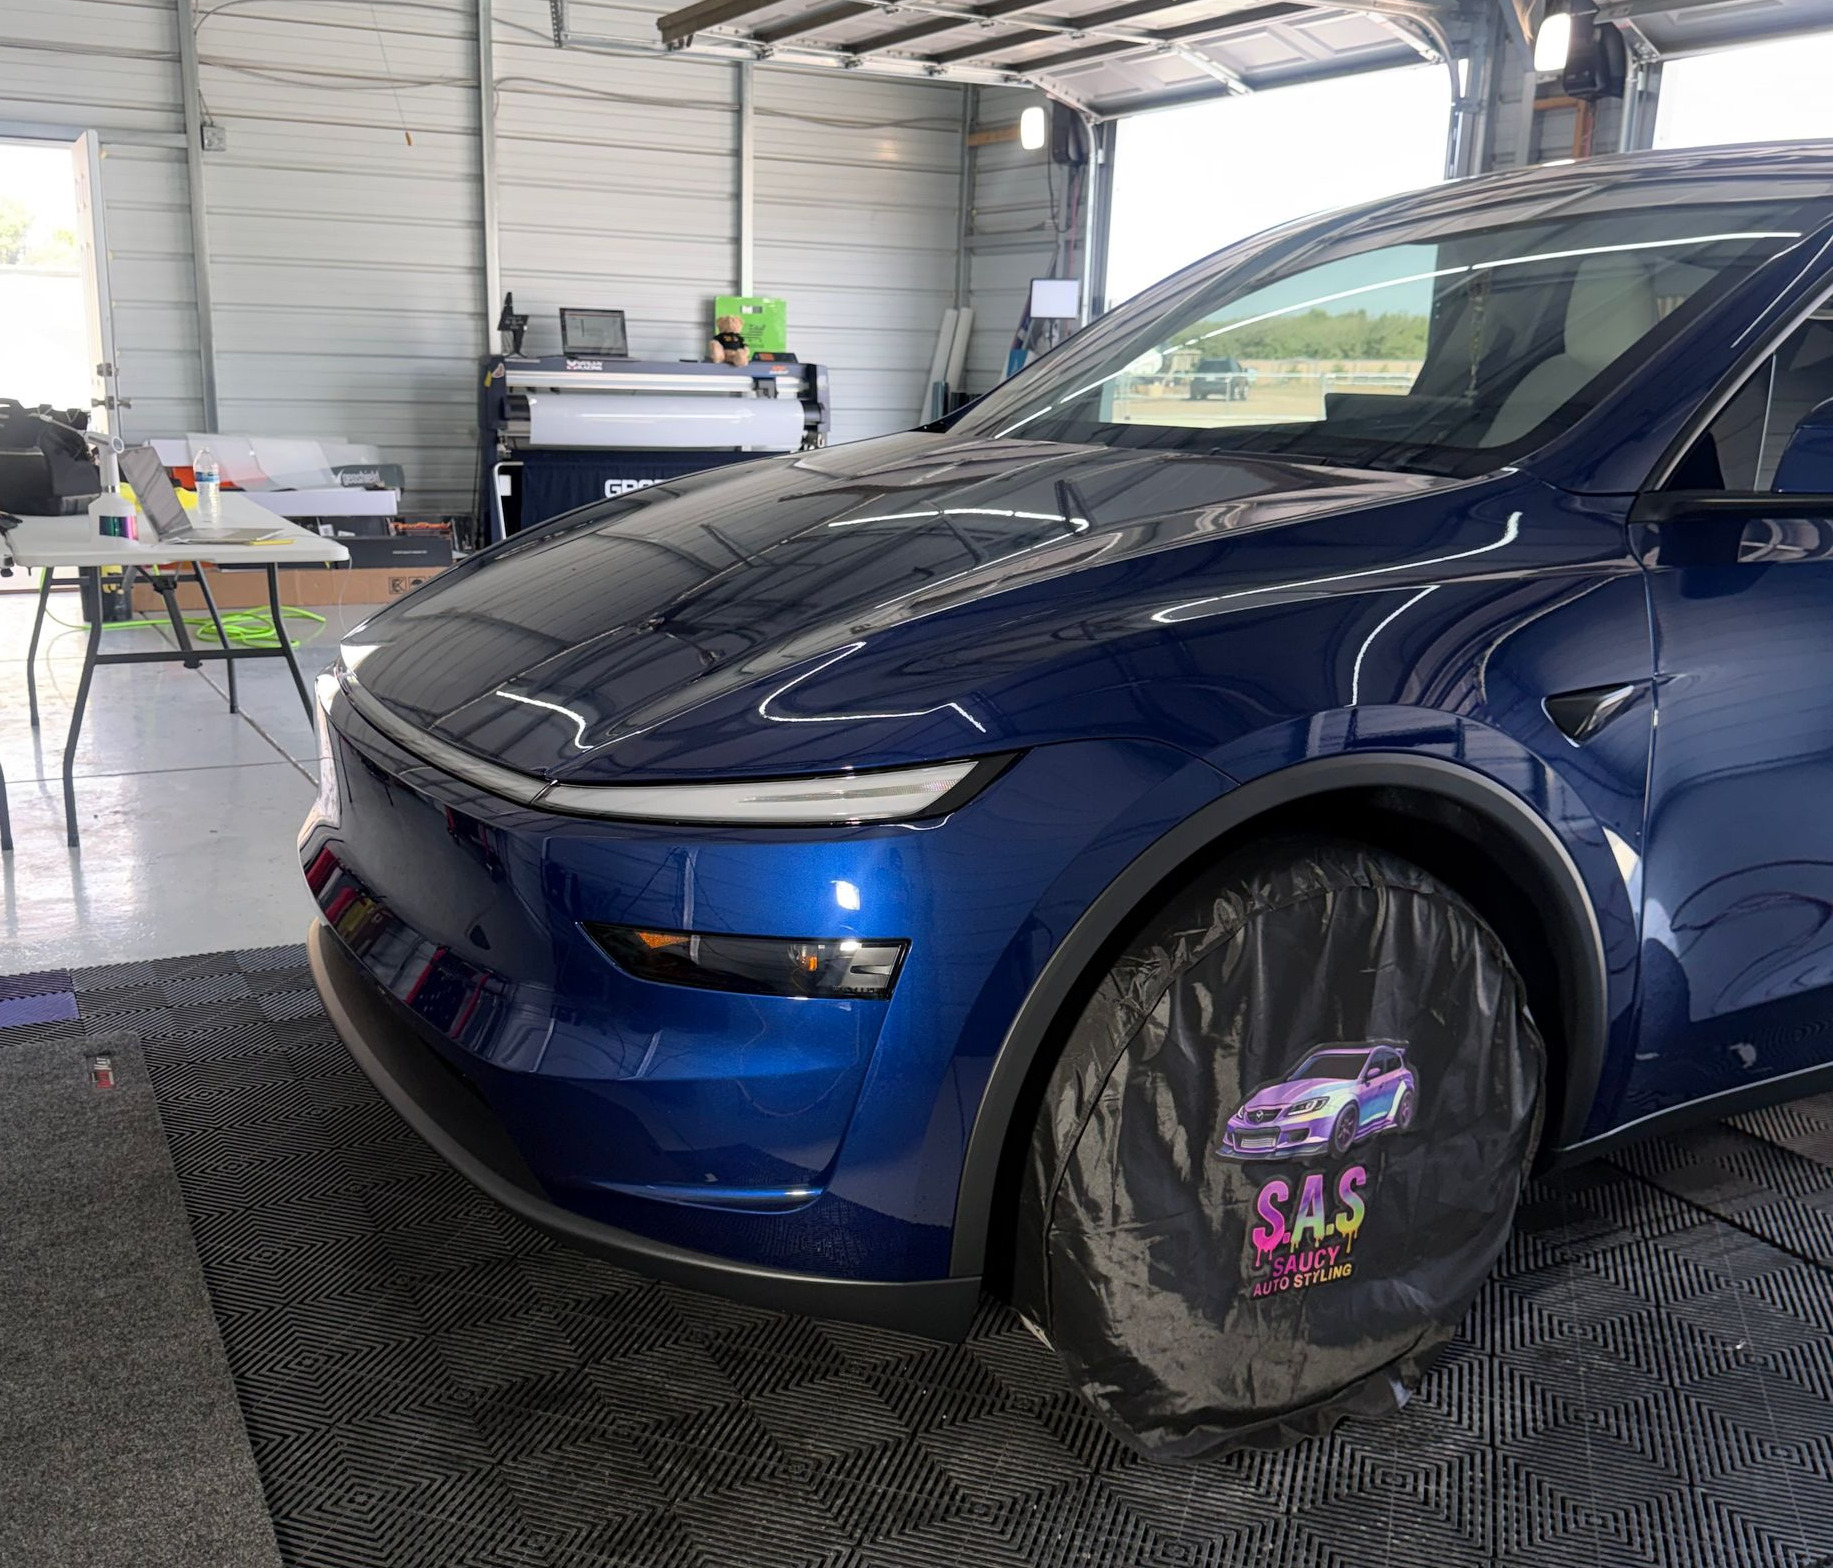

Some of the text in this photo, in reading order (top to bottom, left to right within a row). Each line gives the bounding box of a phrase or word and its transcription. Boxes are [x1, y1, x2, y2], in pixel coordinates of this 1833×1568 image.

[1253, 1166, 1366, 1266] S.A.S
[1273, 1245, 1340, 1277] SAUCY
[1253, 1263, 1352, 1297] AUTO STYLING
